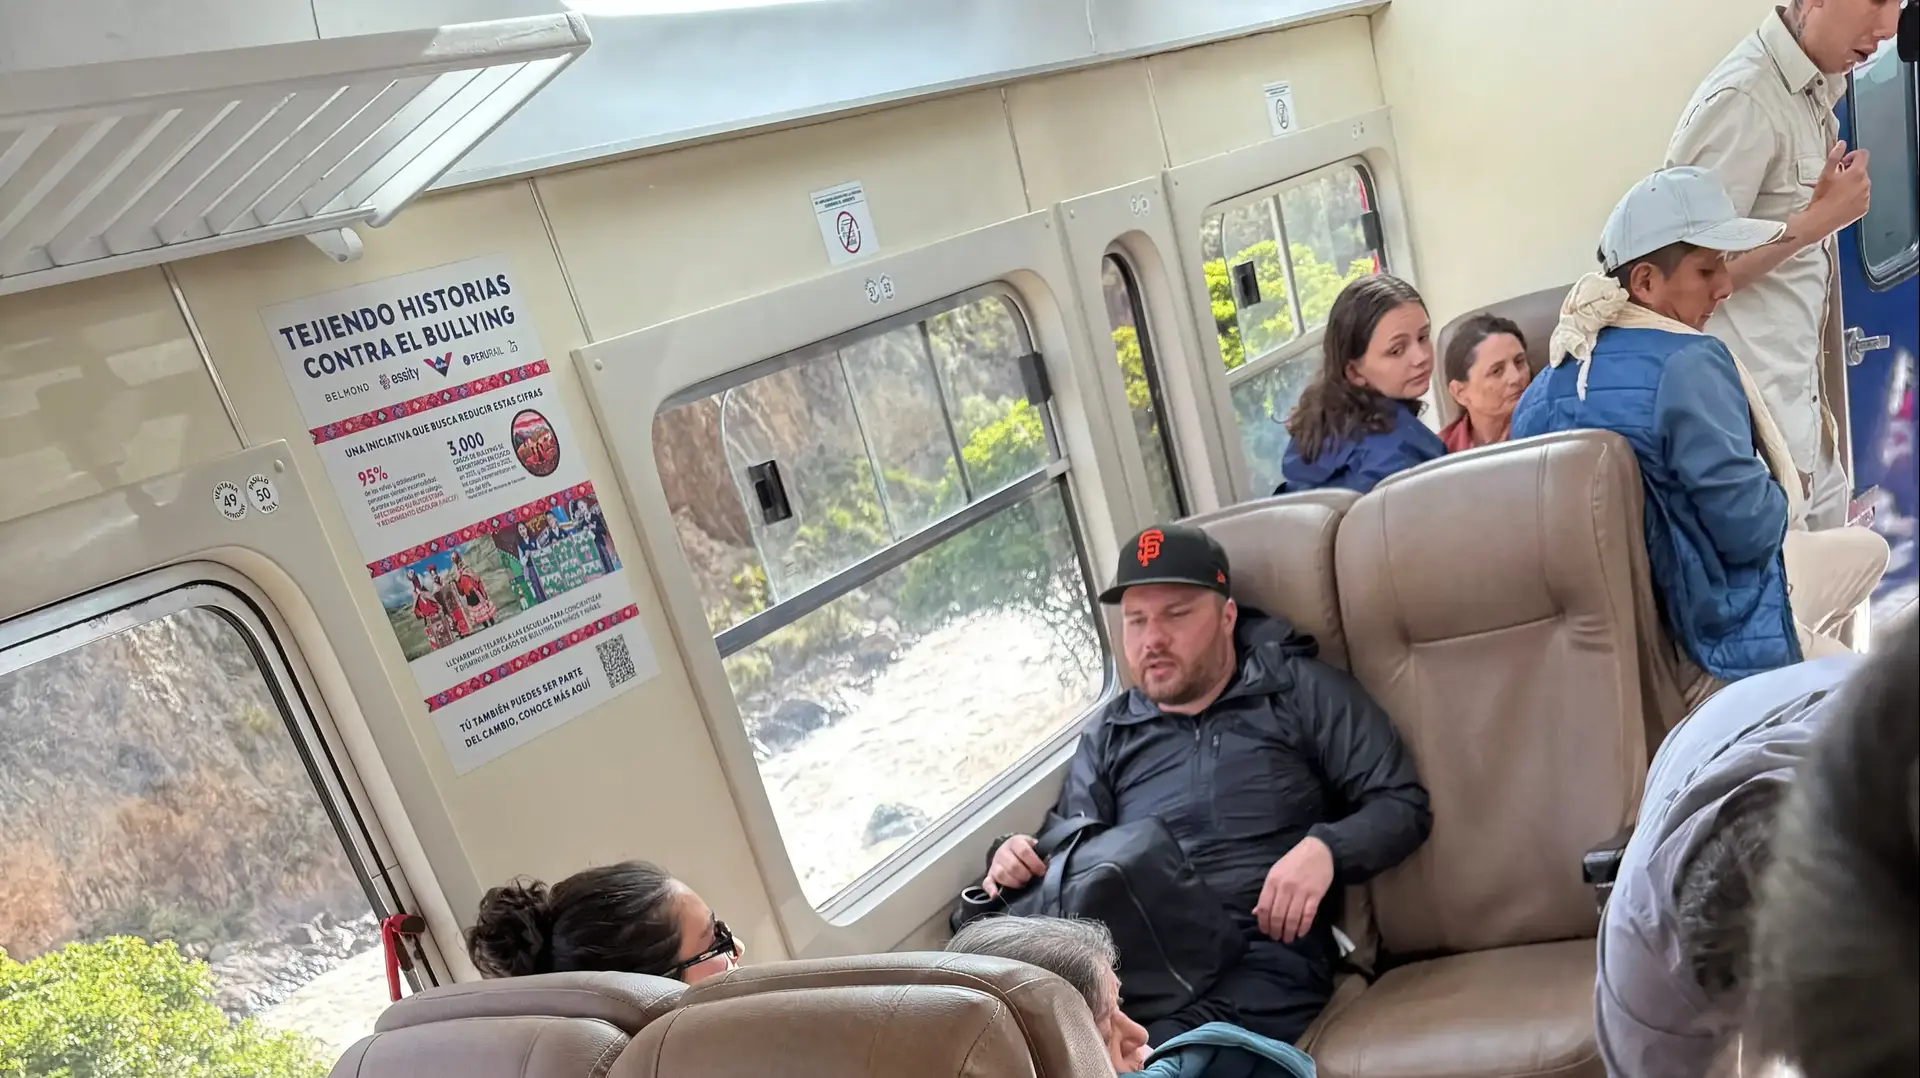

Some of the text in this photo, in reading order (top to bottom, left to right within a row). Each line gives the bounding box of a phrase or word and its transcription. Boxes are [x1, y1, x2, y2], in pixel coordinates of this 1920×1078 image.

[279, 274, 510, 349] TEJIENDO HISTORIAS
[304, 305, 514, 378] CONTRA EL BULLYING
[470, 347, 504, 362] PERURAIL
[391, 367, 419, 384] essity
[324, 383, 369, 402] BELMOND
[345, 388, 543, 457] UNA INICIATIVA QUE BUSCA REDUCIR ESTAS CIFRAS
[447, 432, 484, 456] 3,000
[249, 476, 269, 491] PASILLO
[358, 466, 388, 486] 95%
[215, 482, 239, 500] VENTANA
[224, 493, 237, 507] 49
[256, 487, 271, 502] 50
[262, 501, 278, 512] AISLE
[1137, 529, 1164, 567] SF
[446, 646, 483, 667] LLEVAREMOS
[483, 635, 507, 650] TELARES
[512, 628, 522, 638] LAS
[522, 616, 550, 633] ESCUELAS
[550, 610, 564, 620] PARA
[564, 593, 601, 614] CONCIENTIZAR
[453, 665, 459, 674] Y
[459, 653, 489, 671] DISMINUIR
[489, 647, 501, 657] LOS
[501, 639, 520, 652] CASOS
[520, 635, 527, 643] DE
[528, 623, 554, 639] BULLYING
[554, 620, 562, 628] EN
[578, 609, 584, 617] Y
[459, 667, 583, 732] TÚ TAMBIÉN PUEDES SER PARTE
[465, 677, 590, 747] DEL CAMBIO, CONOCE MÁS AQUÍ
